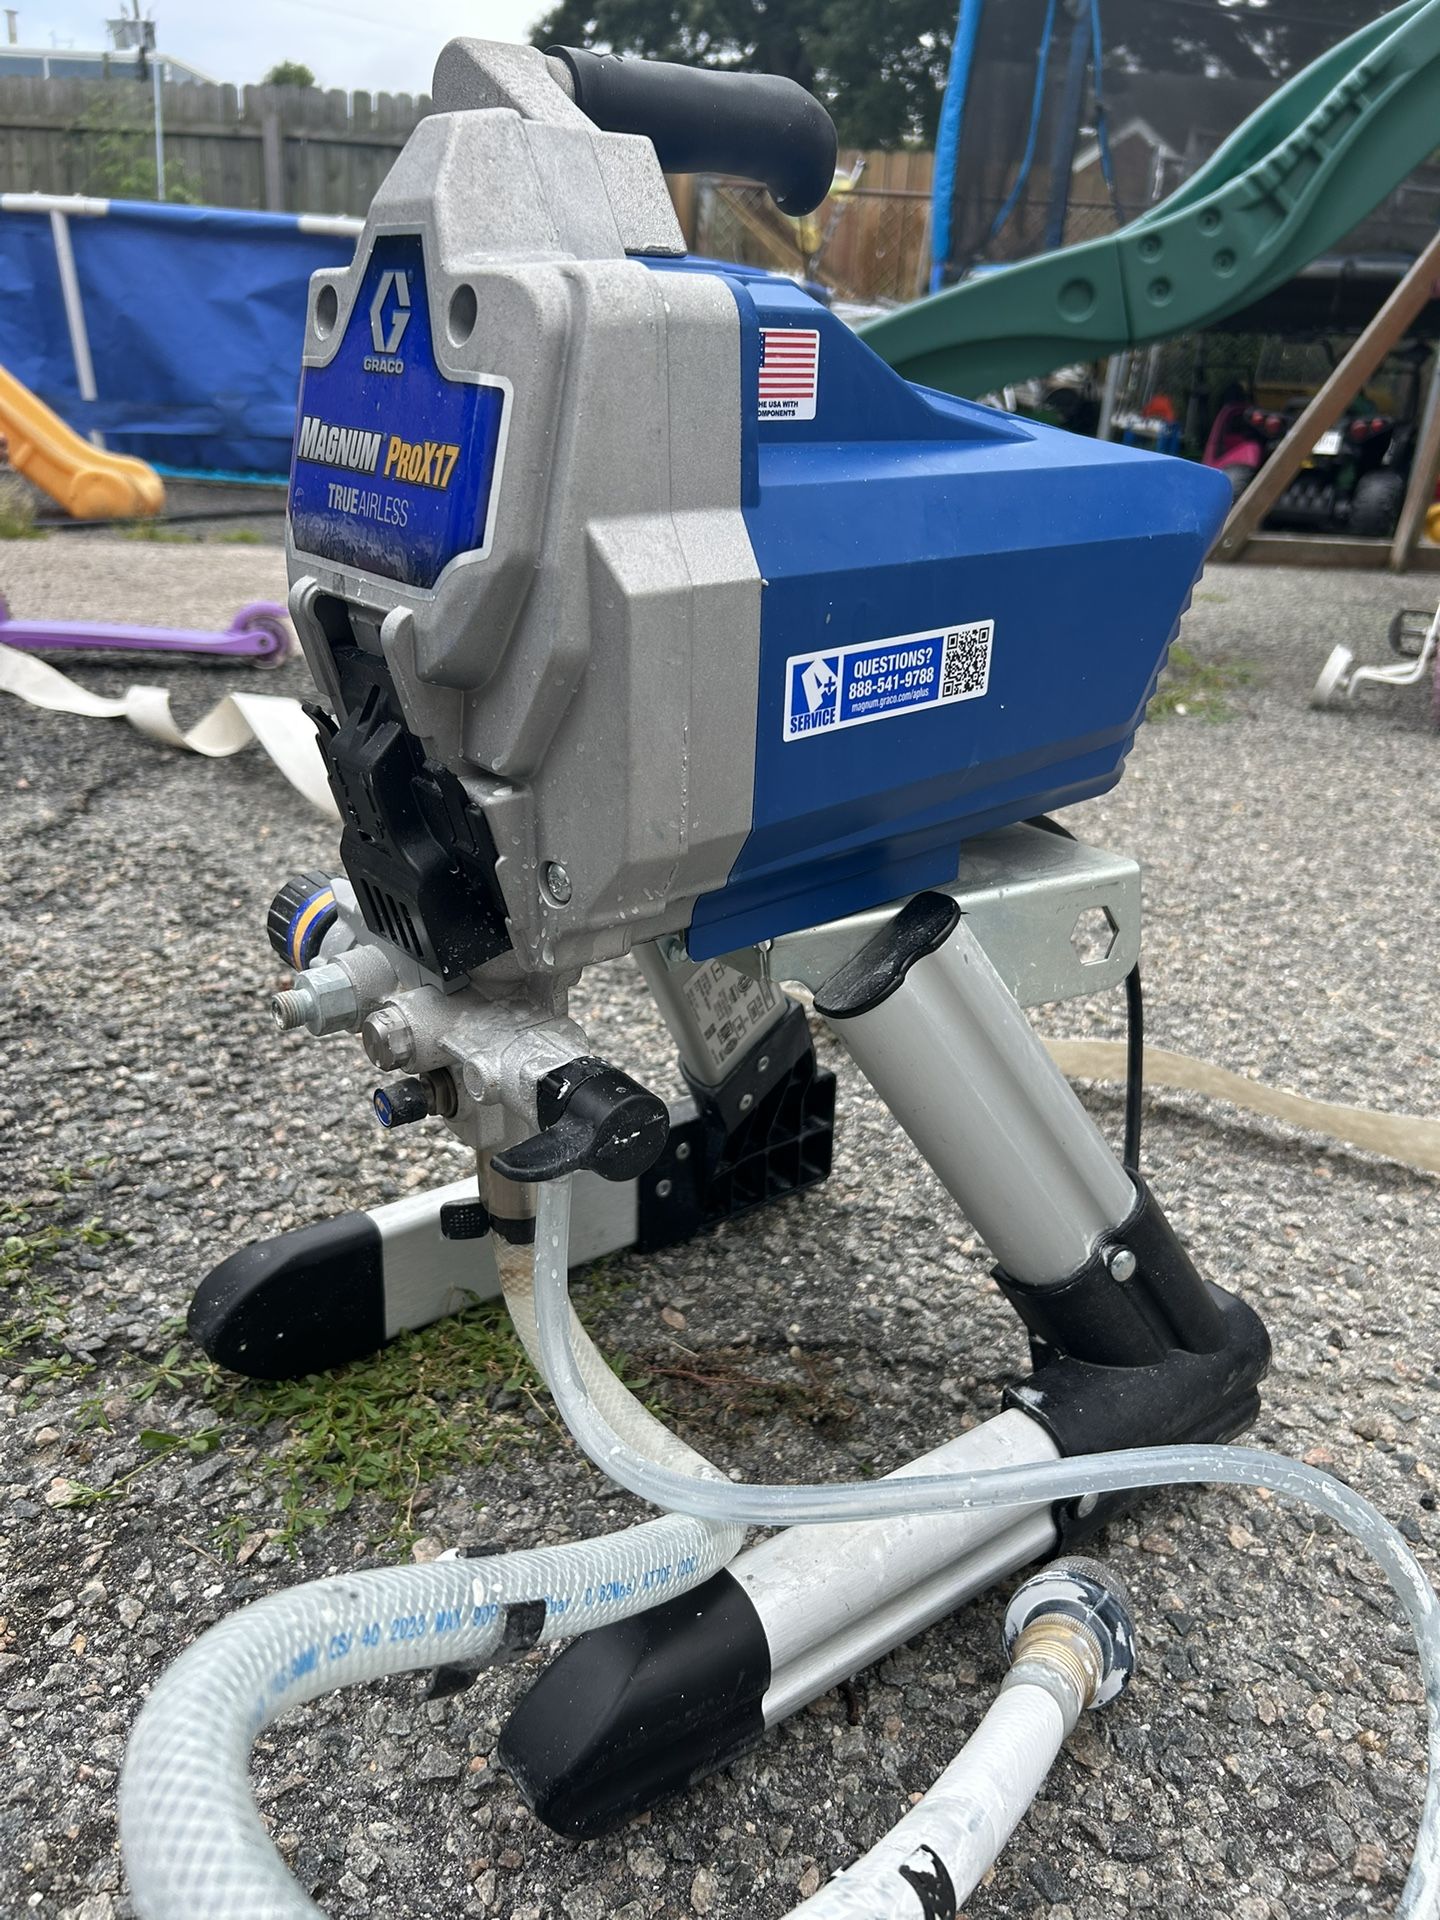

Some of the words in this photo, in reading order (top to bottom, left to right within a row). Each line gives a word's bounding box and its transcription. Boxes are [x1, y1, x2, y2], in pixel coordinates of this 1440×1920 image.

[363, 356, 404, 374] GRACO
[854, 647, 933, 679] QUESTIONS?
[849, 667, 935, 700] 888-541-9788
[851, 687, 929, 713] magnum.graco.com/aplus
[790, 708, 836, 734] SERVICE
[389, 1614, 426, 1642] 2023
[434, 1606, 463, 1634] MAX
